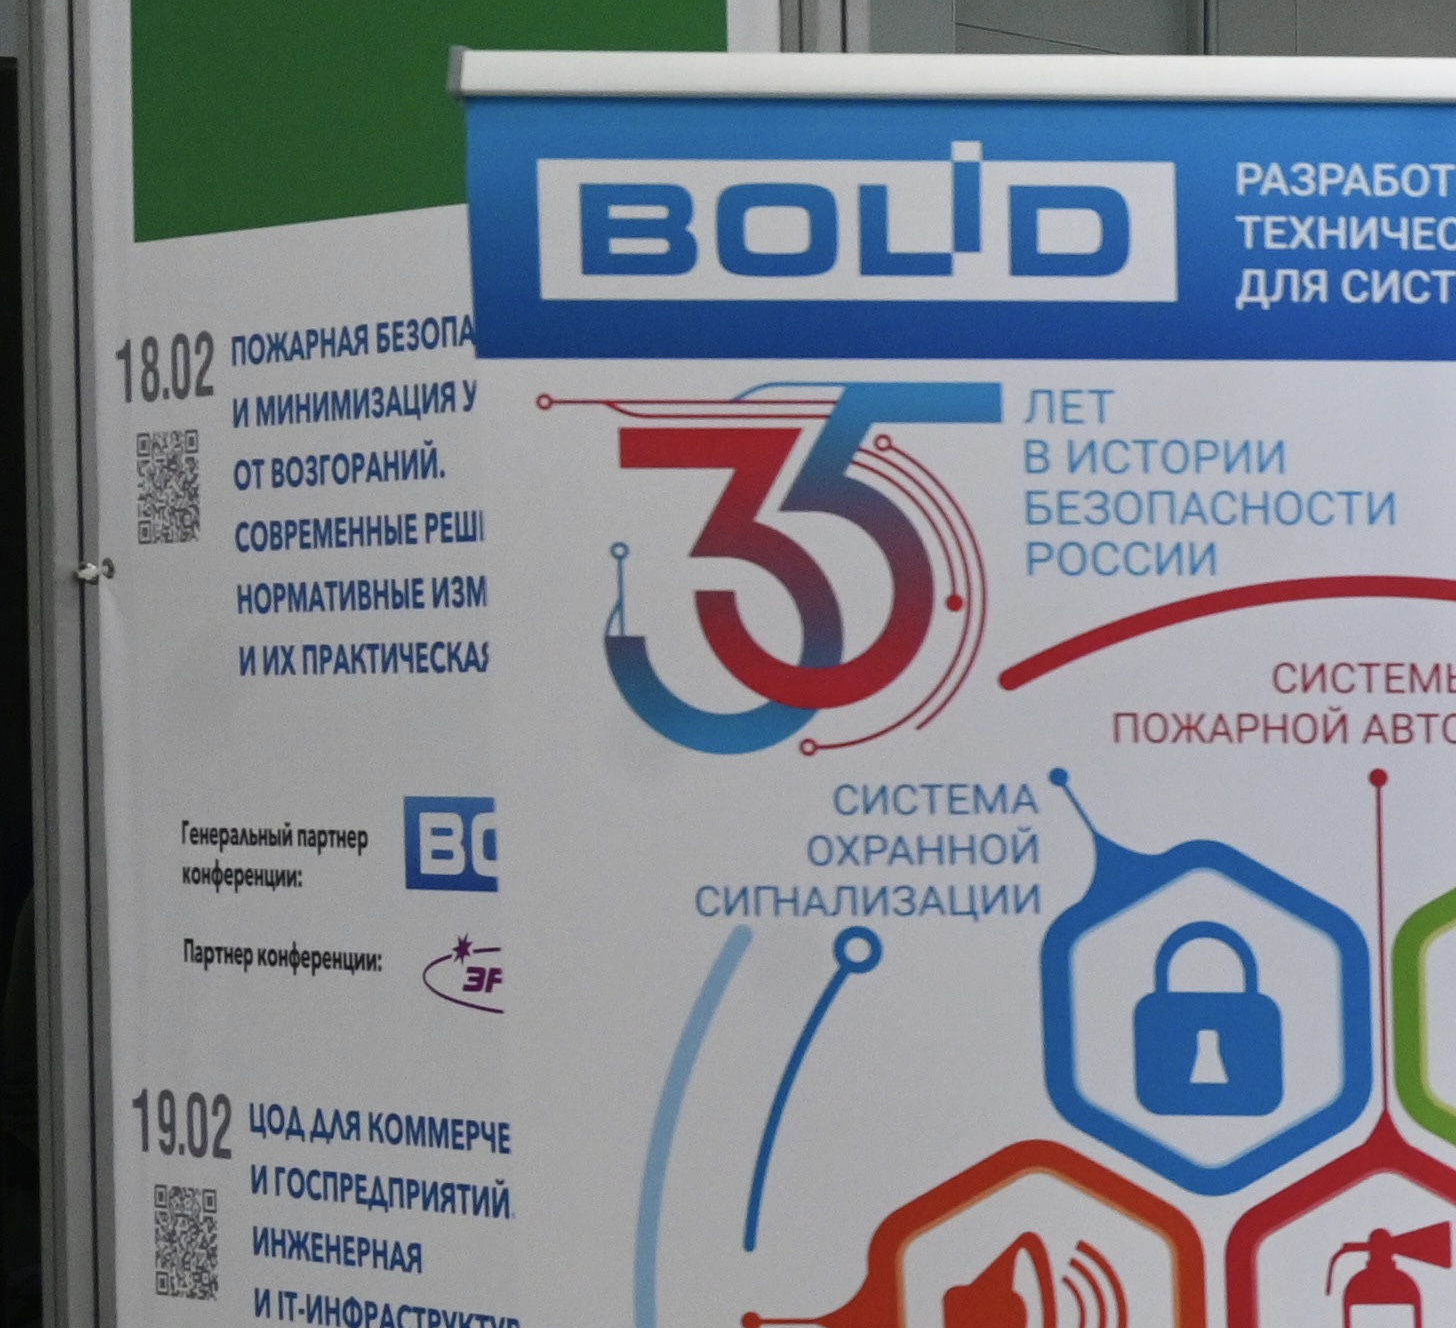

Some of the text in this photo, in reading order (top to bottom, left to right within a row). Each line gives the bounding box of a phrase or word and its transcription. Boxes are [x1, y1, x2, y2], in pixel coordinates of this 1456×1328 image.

[1236, 271, 1329, 310] ДЛЯ
[231, 325, 369, 366] ПОЖАРНАЯ
[116, 331, 214, 403] 18.02
[233, 398, 249, 427] И
[256, 382, 456, 425] МИНИМИЗАЦИЯ
[1023, 389, 1116, 426] ЛЕТ
[234, 440, 445, 490] ОТ ВОЗГОРАНИЙ.
[1025, 440, 1286, 475] В ИСТОРИИ
[1025, 491, 1396, 526] БЕЗОПАСНОСТИ
[235, 510, 485, 552] СОВРЕМЕННЫЕ РЕШ
[1026, 542, 1218, 577] РОССИИ
[237, 579, 424, 614] НОРМАТИВНЫЕ
[240, 647, 255, 675] И
[263, 645, 295, 675] ИХ
[1114, 703, 1349, 745] ПОЖАРНОЙ
[832, 783, 1040, 817] СИСТЕМА
[181, 820, 368, 856] Генеральный партнер
[807, 827, 1041, 867] ОХРАННОЙ
[182, 860, 302, 892] конференции:
[695, 884, 1042, 924] СИГНАЛИЗАЦИИ
[184, 938, 382, 976] Партнер конференции:
[132, 1088, 232, 1160] 19.02
[249, 1102, 511, 1154] ЦОД ДЛЯ КОММЕРЧЕ
[251, 1165, 268, 1194] И
[253, 1226, 422, 1274] ИНЖЕНЕРНАЯ
[255, 1288, 271, 1318] И
